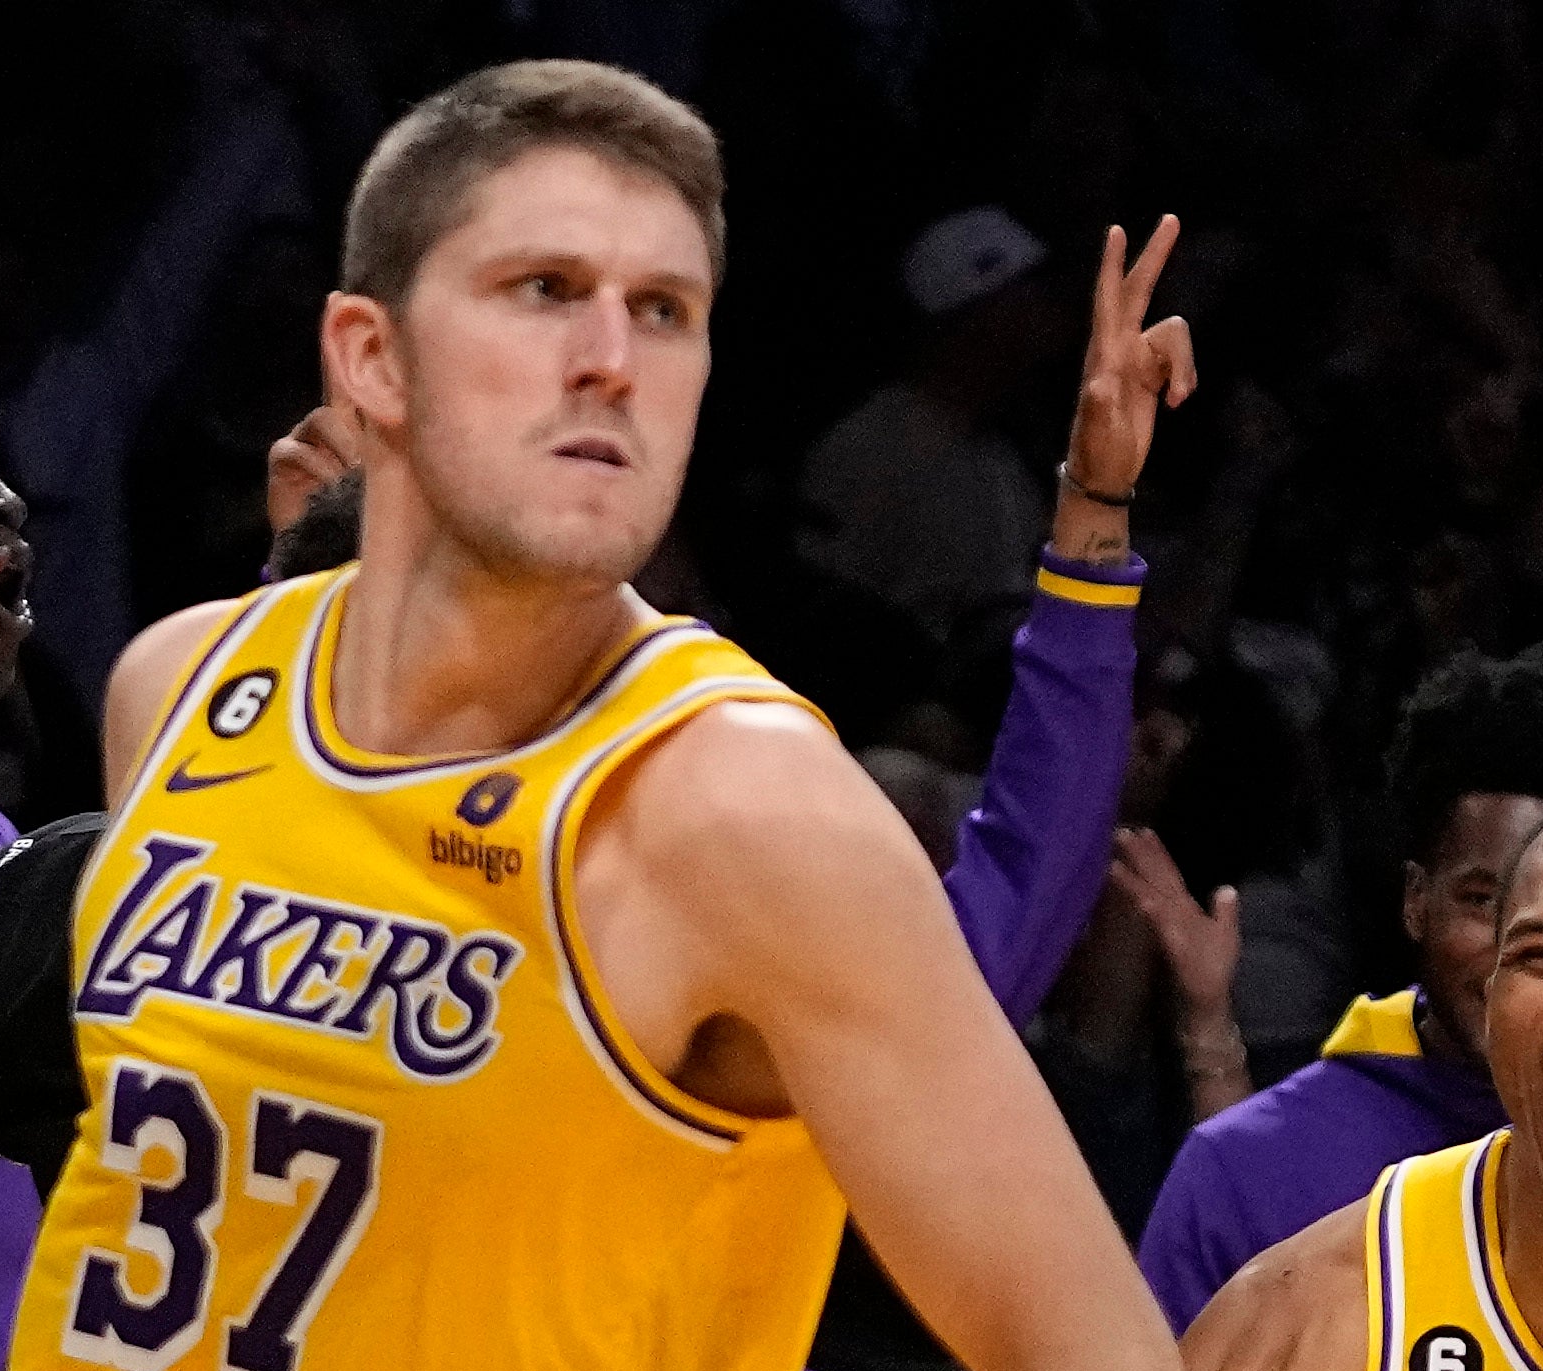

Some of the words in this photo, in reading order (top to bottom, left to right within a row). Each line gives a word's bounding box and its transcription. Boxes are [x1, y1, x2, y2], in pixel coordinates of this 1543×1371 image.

[220, 674, 271, 731] 6
[430, 829, 524, 887] bibigo
[75, 838, 525, 1084] LAKERS
